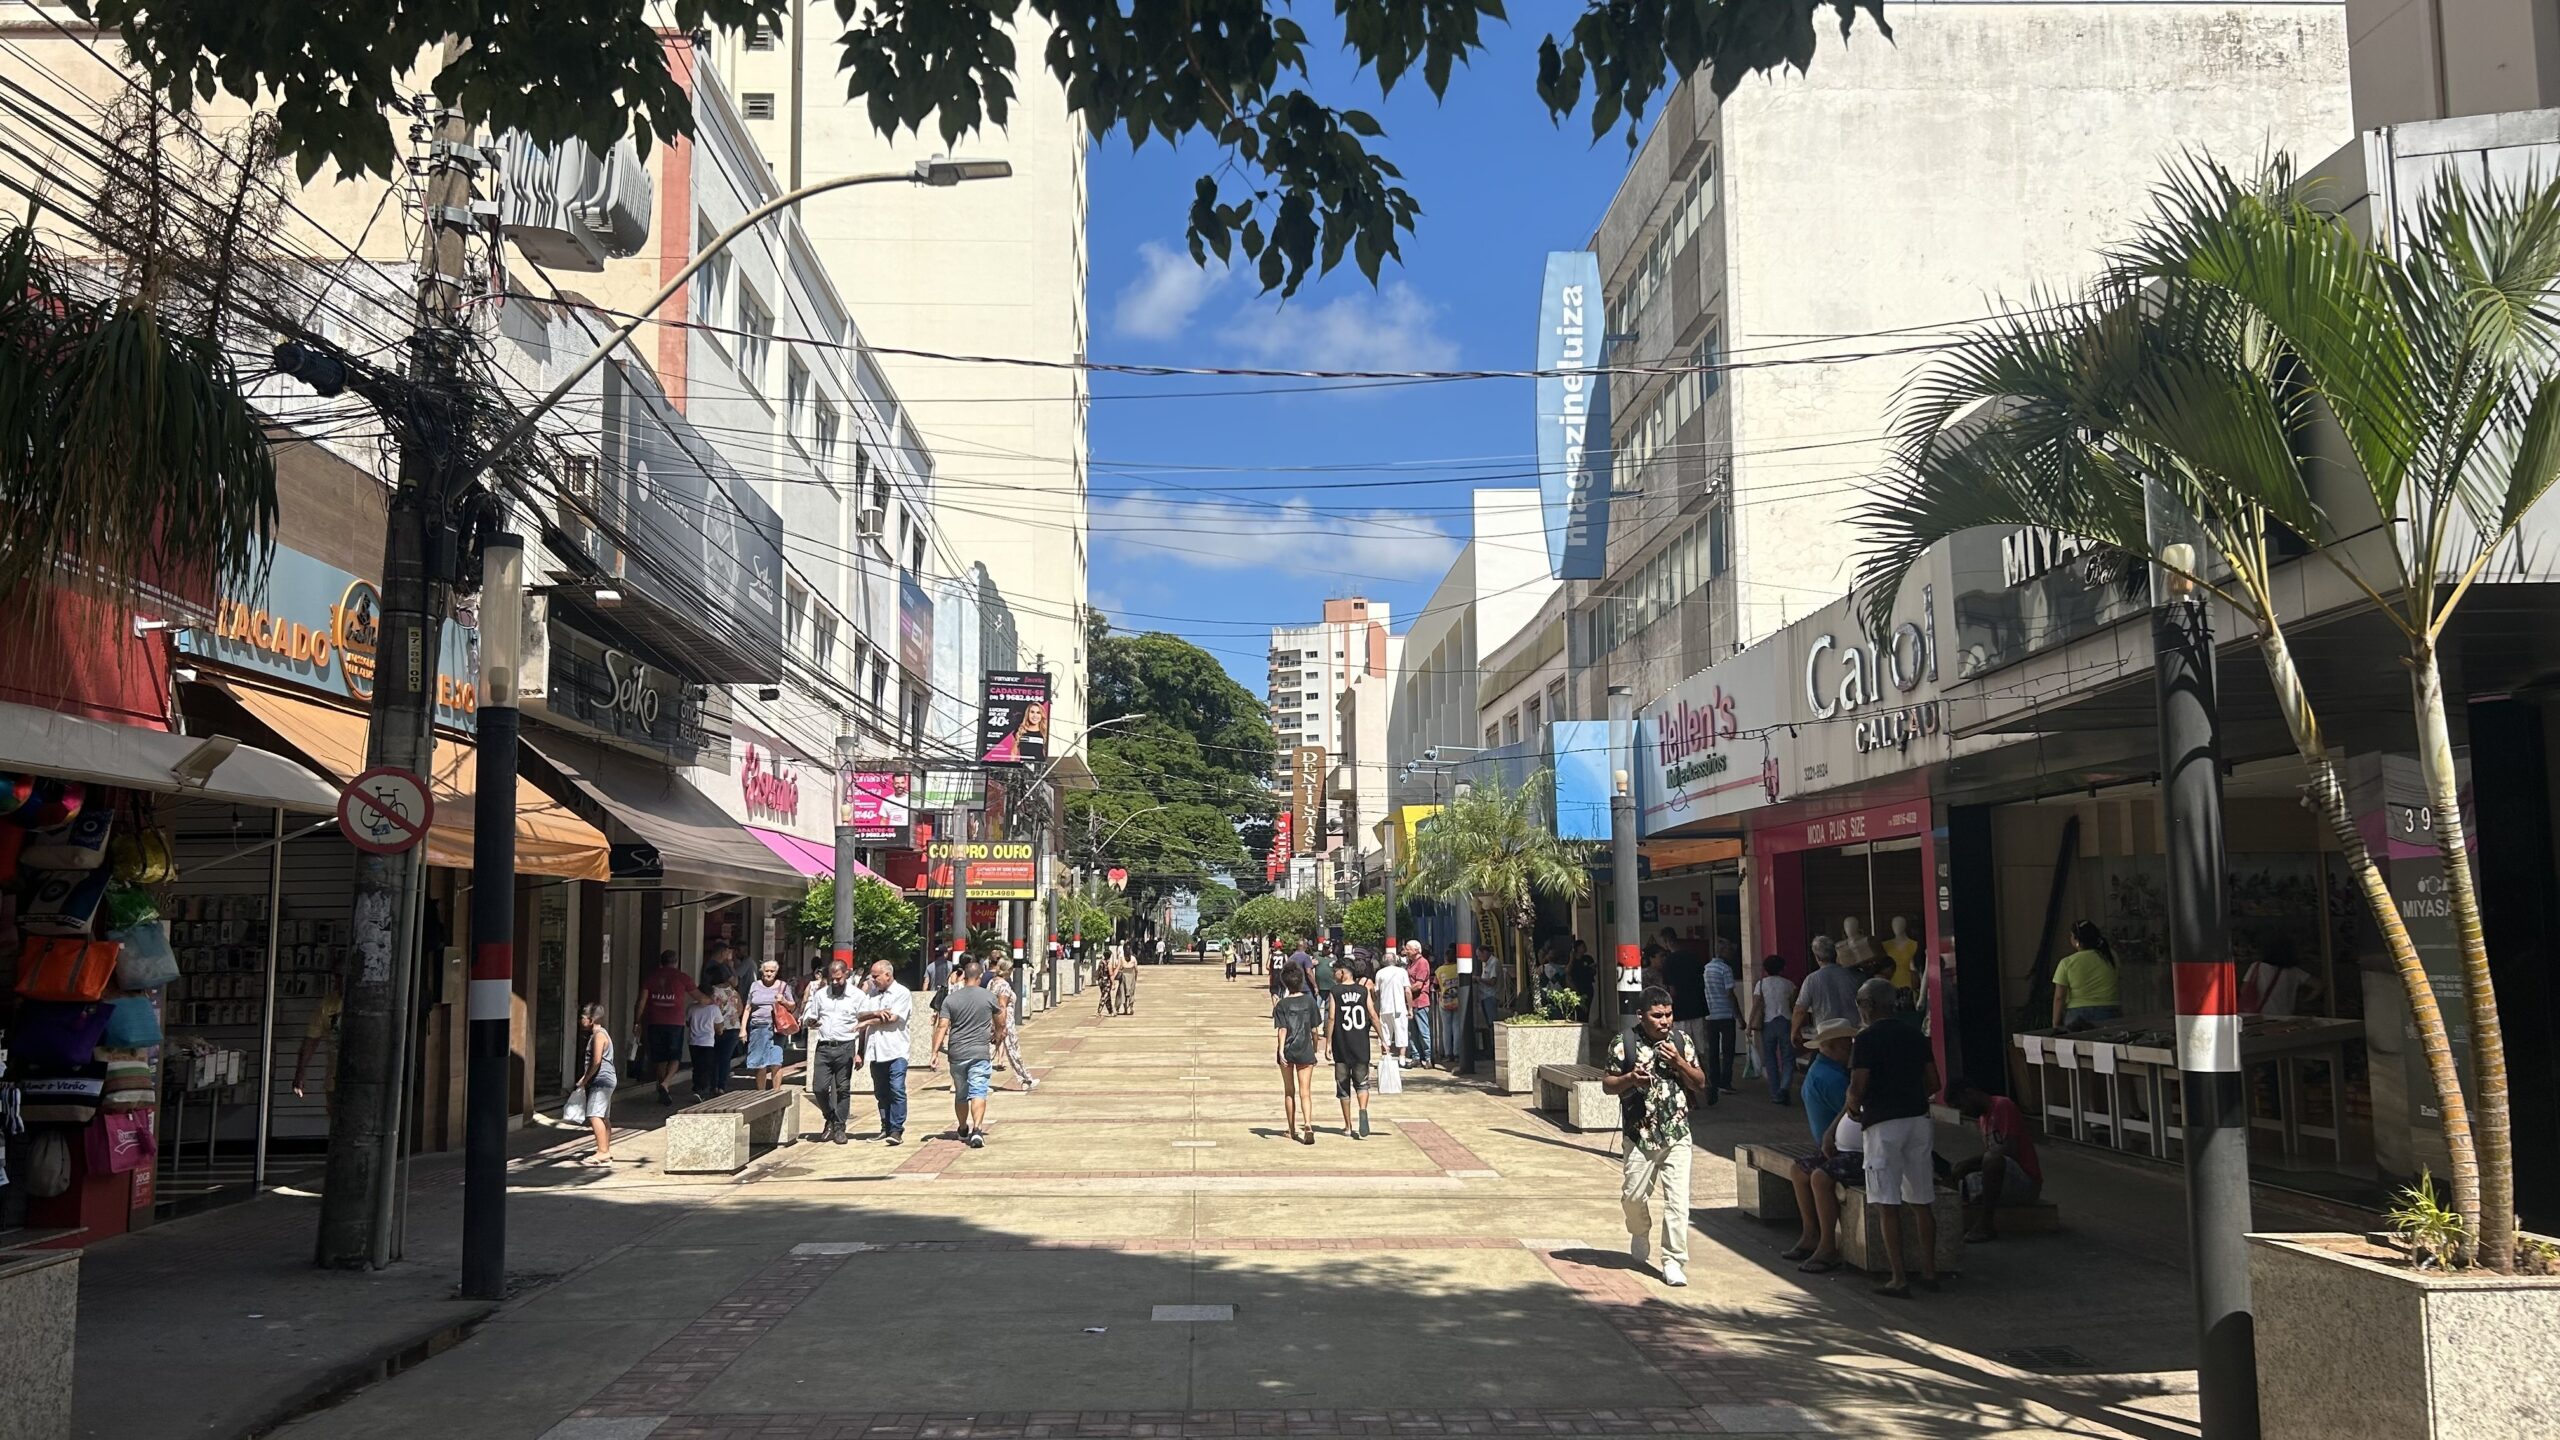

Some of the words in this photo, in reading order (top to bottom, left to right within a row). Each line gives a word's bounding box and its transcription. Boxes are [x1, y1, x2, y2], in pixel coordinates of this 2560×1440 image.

[1555, 285, 1594, 547] magazineluiza
[217, 598, 331, 668] TACADO
[1806, 584, 1938, 720] Carol
[590, 649, 658, 733] Seiko
[990, 687, 1045, 696] CADASTRE-SE
[1658, 684, 1738, 767] Hellen's
[1301, 751, 1319, 850] DENTISTAS
[1807, 825, 1826, 845] MODA
[1829, 820, 1847, 841] PLUS
[1850, 816, 1865, 837] SIZE
[993, 844, 1032, 859] OURO
[1273, 955, 1283, 969] 23
[1340, 1004, 1366, 1031] 30
